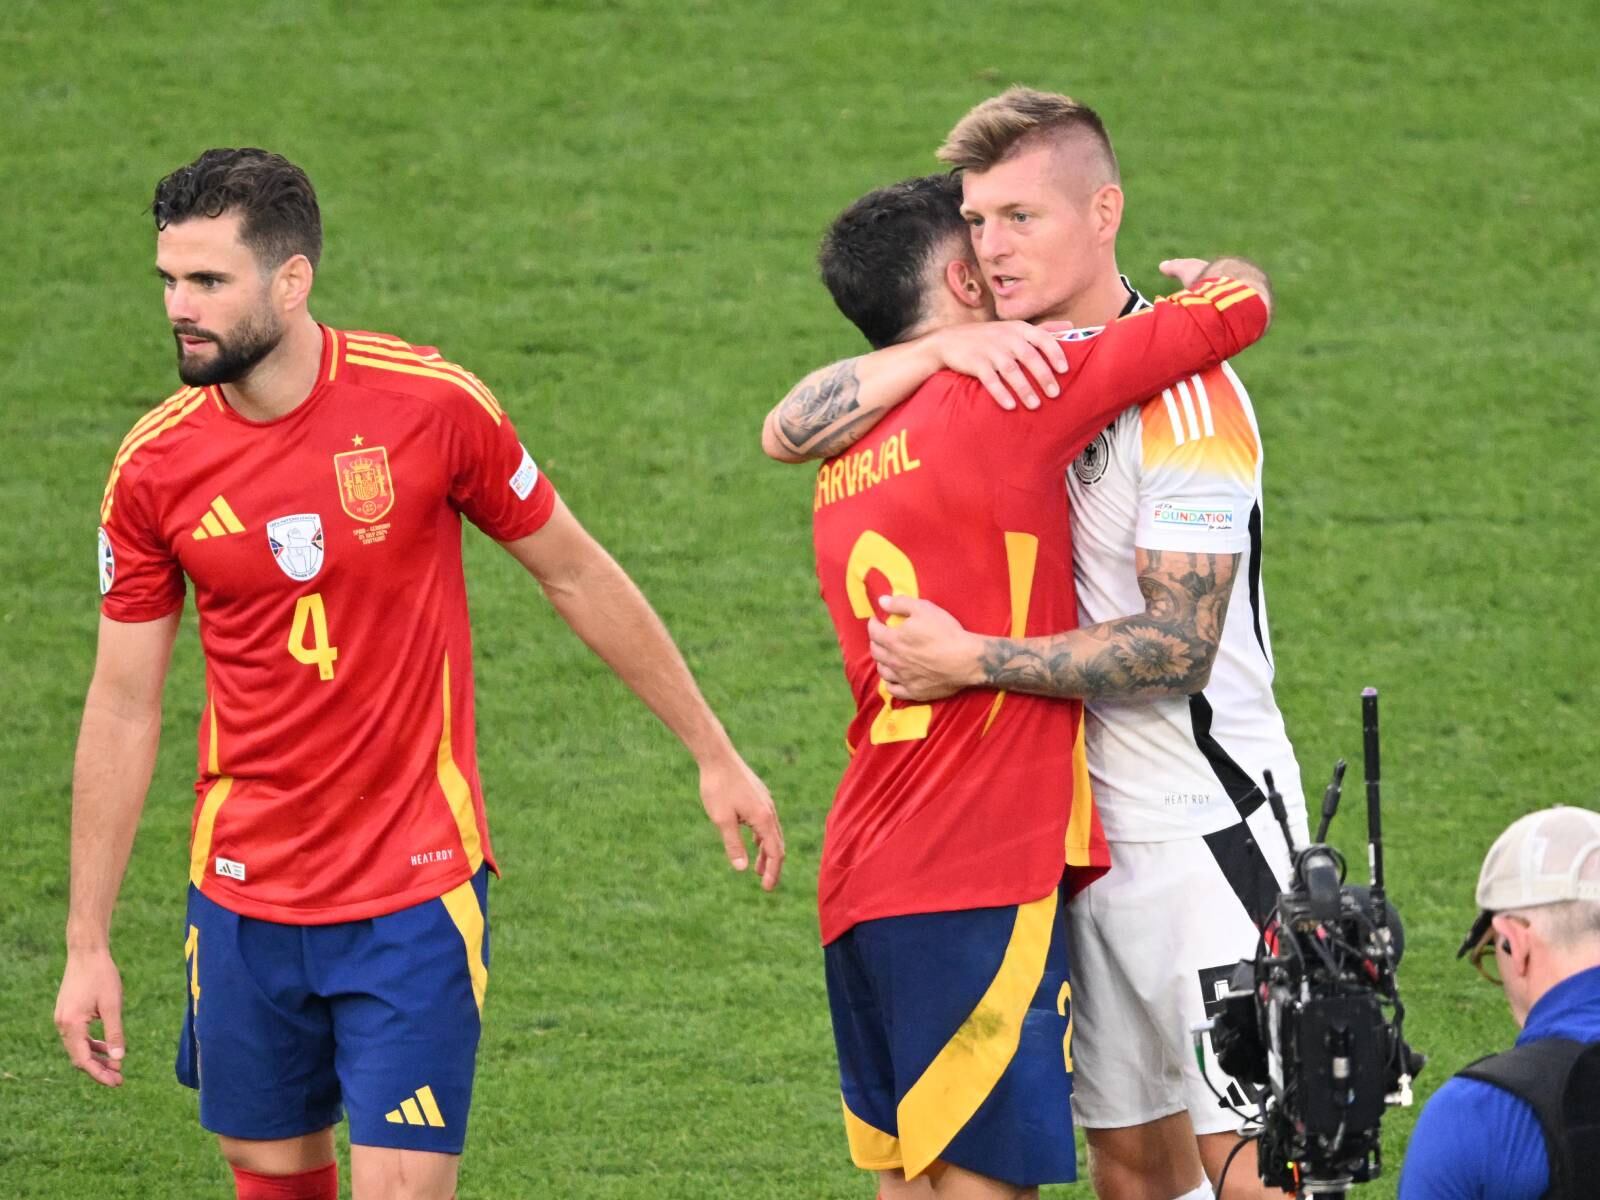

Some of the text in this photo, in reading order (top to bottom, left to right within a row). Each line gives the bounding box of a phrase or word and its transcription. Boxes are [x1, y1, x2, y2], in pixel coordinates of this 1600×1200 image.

[814, 428, 921, 512] ARVAJAL
[288, 592, 338, 681] 4
[1164, 793, 1210, 806] HEATRDY
[410, 848, 454, 866] HEAT.RDY
